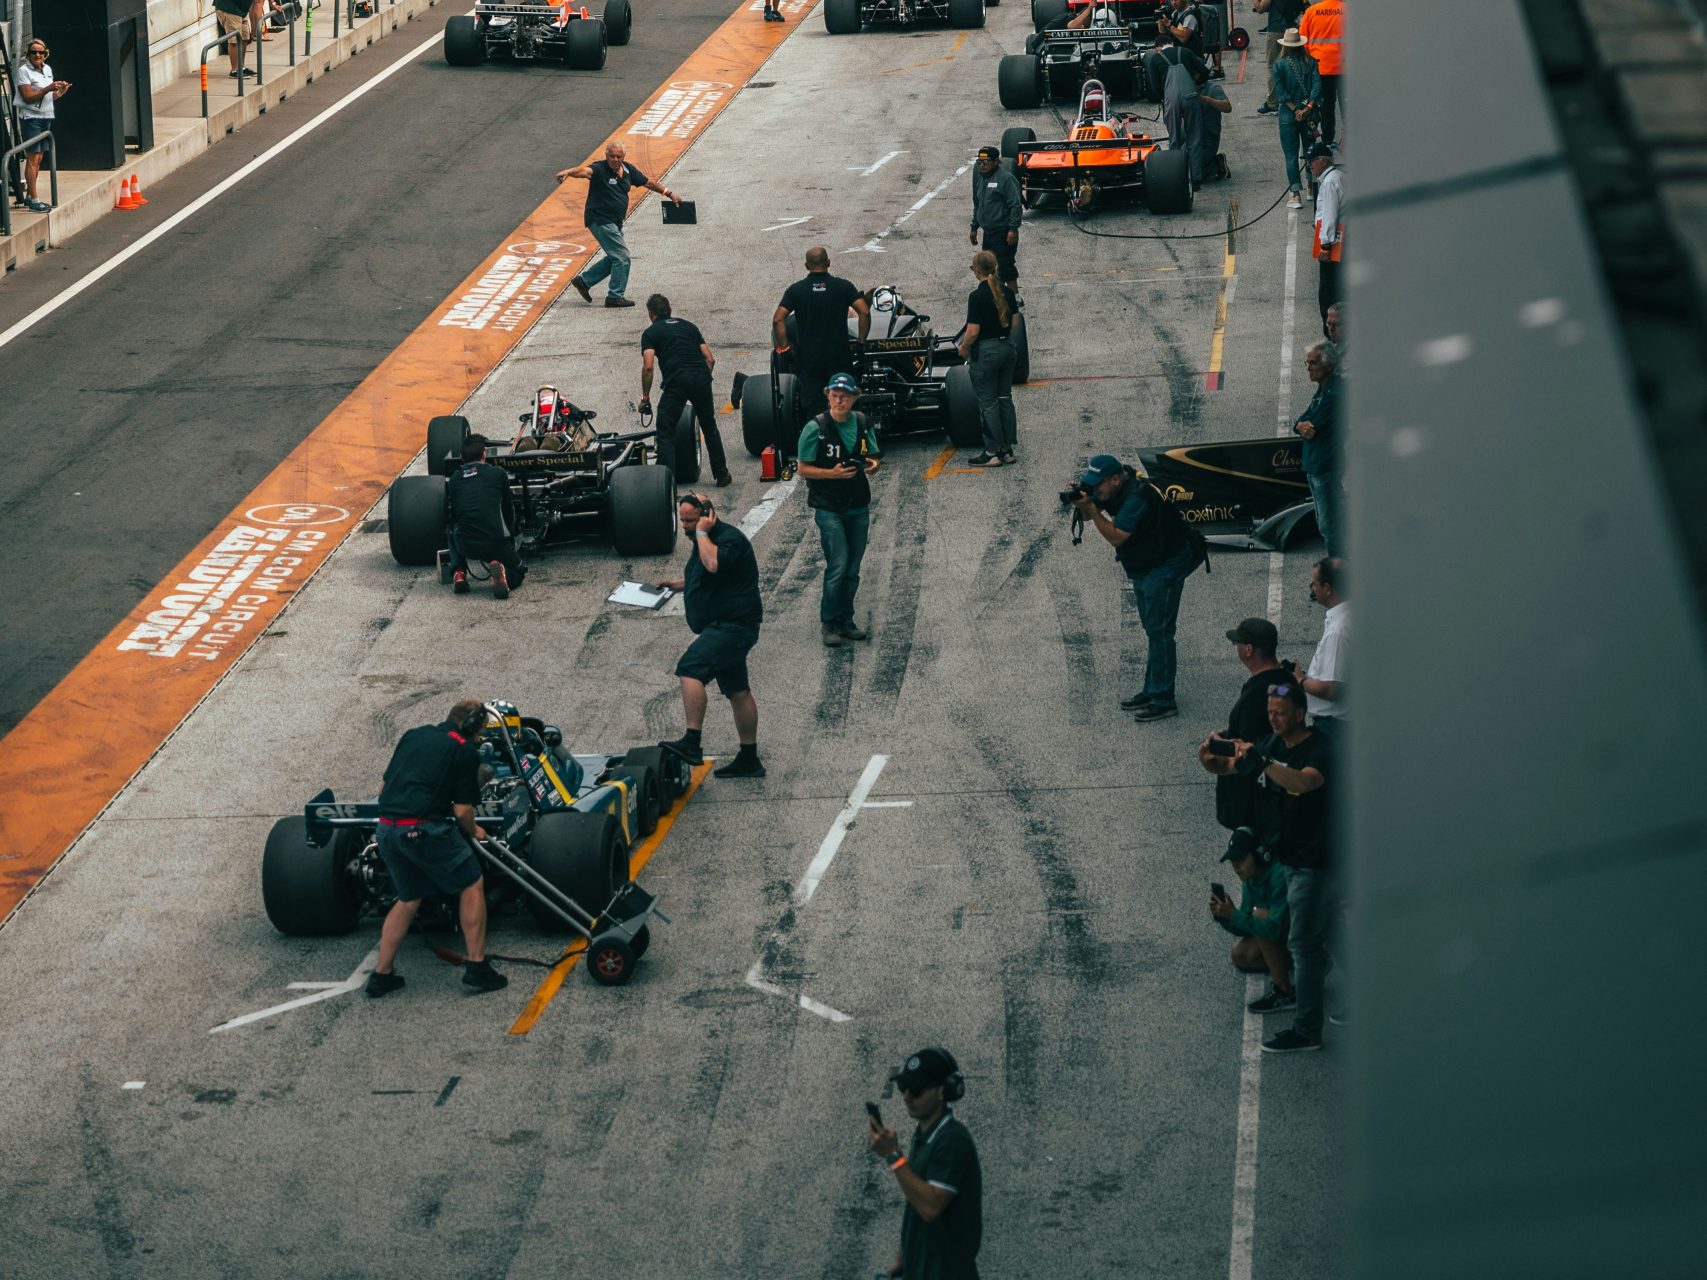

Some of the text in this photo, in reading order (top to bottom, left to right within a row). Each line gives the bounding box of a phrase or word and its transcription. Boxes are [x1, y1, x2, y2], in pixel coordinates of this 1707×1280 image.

[484, 5, 553, 13] Marlboro
[1083, 29, 1123, 37] COLOMBIA
[878, 339, 921, 350] Special
[826, 443, 841, 458] 31
[537, 454, 584, 466] Special
[188, 530, 326, 661] CM.COM CIRCUIT
[315, 804, 358, 819] elf
